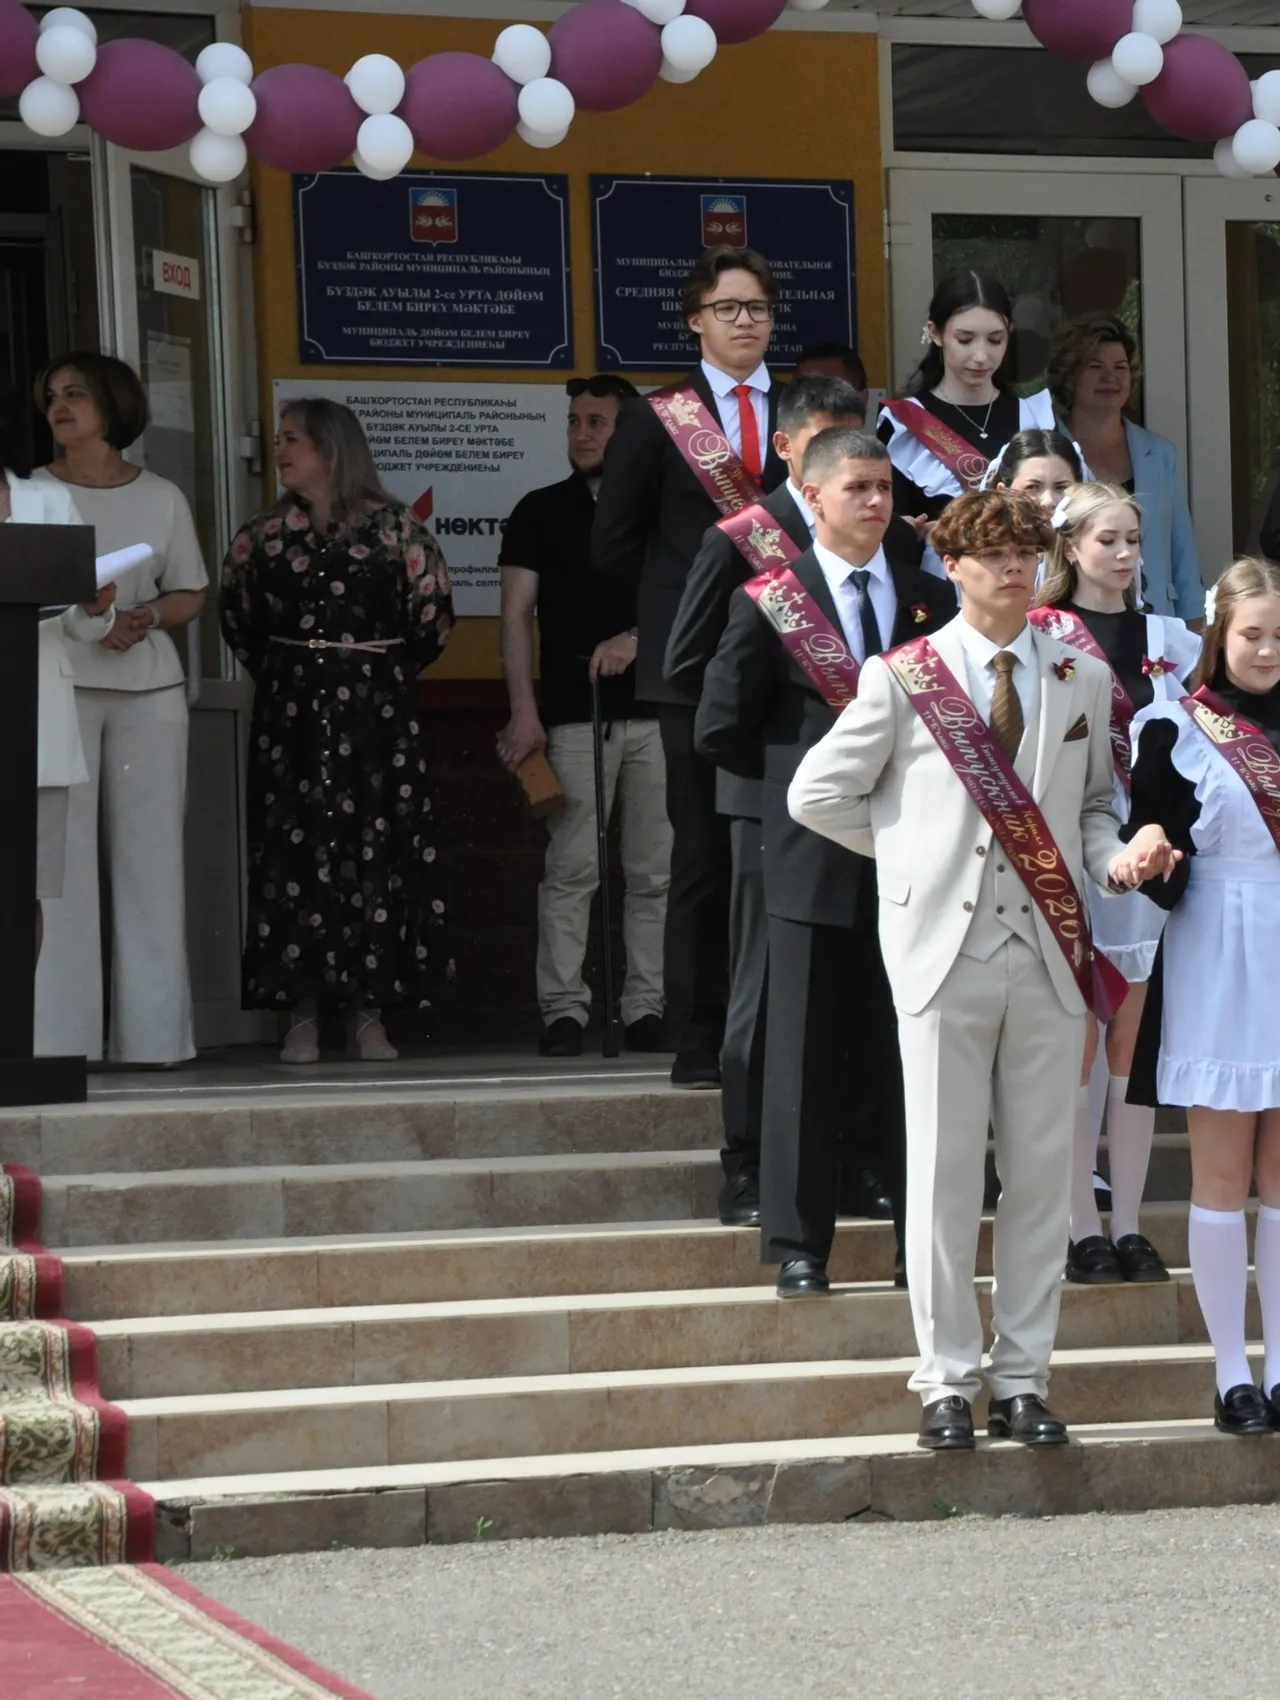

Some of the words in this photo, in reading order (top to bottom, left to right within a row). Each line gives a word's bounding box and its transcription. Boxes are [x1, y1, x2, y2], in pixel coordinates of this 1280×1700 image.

[616, 257, 697, 267] МУНИЦИПАЛЬН
[769, 260, 834, 269] ОВАТЕЛЬНОЕ
[162, 262, 191, 291] ВХОД
[379, 287, 432, 299] АУЫЛЫ
[459, 289, 493, 301] УРТА
[615, 286, 675, 298] СРЕДНЯЯ
[357, 300, 403, 312] БЕЛЕМ
[359, 408, 404, 418] РАЙОНЫ
[406, 410, 476, 421] МУНИЦИПАЛЬ
[408, 424, 447, 432] АУЫЛЫ
[449, 424, 472, 432] 2-СЕ
[474, 424, 500, 433] УРТА
[369, 434, 392, 444] ЙӨМ
[394, 436, 430, 445] БЕЛЕМ
[467, 437, 515, 446] МӘКТӘБЕ
[371, 448, 413, 458] ЦИПАЛЬ
[455, 450, 490, 459] БЕЛЕМ
[375, 462, 413, 472] ЮДЖЕТ
[930, 696, 1029, 842] Выпускник
